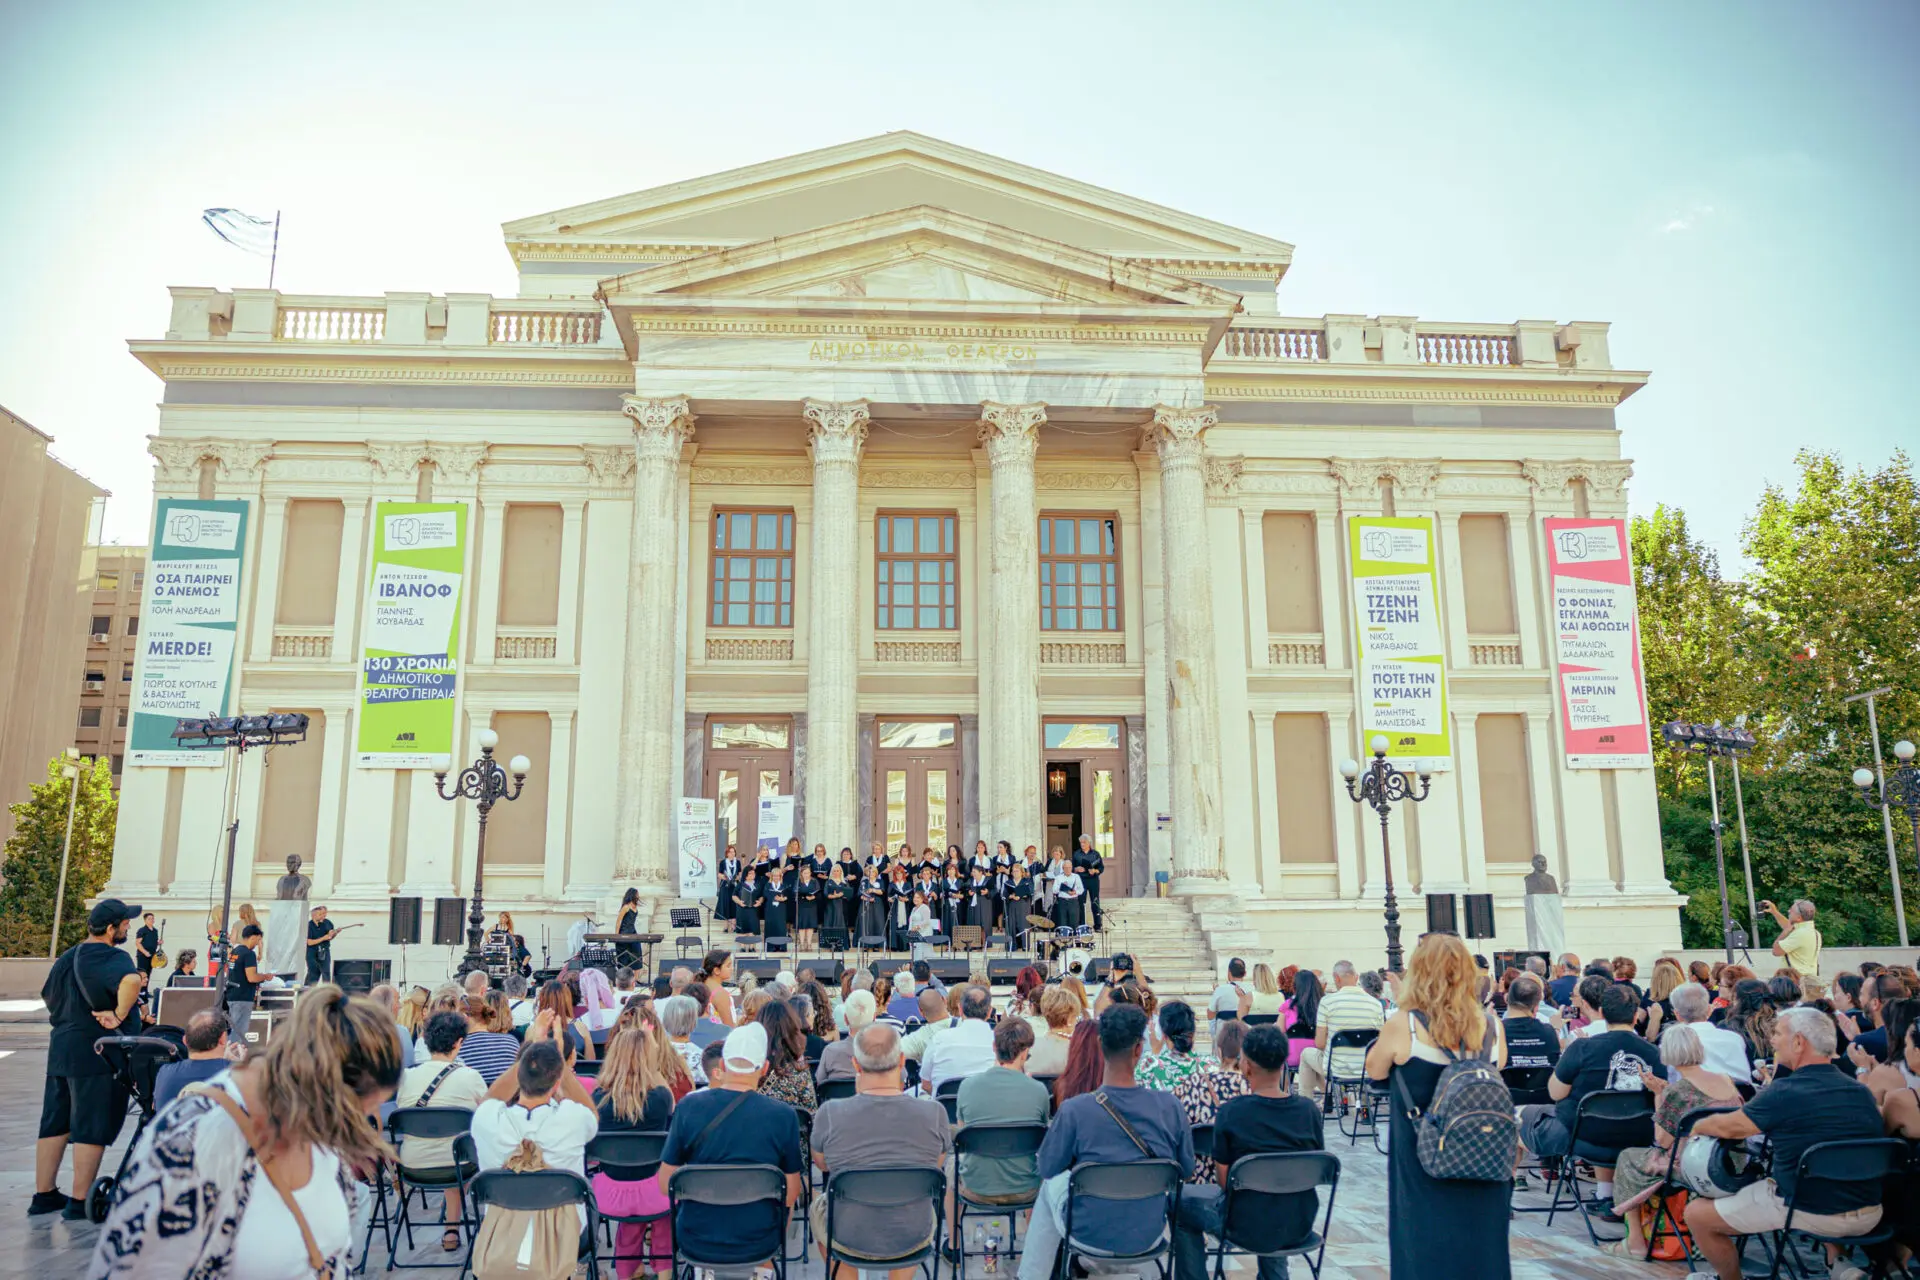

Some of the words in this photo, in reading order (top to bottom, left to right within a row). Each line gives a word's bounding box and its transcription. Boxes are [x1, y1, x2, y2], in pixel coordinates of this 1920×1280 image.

[809, 341, 924, 358] ΔΗΜΟΤΙΚΟΝ
[946, 344, 1037, 359] ΘΕΑΤΡΟΝ
[155, 573, 181, 584] ΟΣΑ
[184, 574, 233, 585] ΠΑΙΡΝΕΙ
[154, 586, 164, 596] Ο
[167, 586, 220, 597] ΑΝΕΜΟΣ
[379, 583, 452, 598] ΙΒΑΝΟΦ
[1366, 594, 1418, 608] ΤΖΕΝΗ
[1558, 598, 1567, 607] Ο
[1569, 598, 1616, 609] ΦΟΝΙΑΣ,
[152, 606, 173, 615] ΙΟΛΗ
[175, 606, 221, 615] ΑΝΔΡΕΑΔΗ
[377, 607, 414, 616] ΓΙΑΝΝΗΣ
[1559, 610, 1609, 619] ΕΓΚΛΗΜΑ
[1367, 609, 1419, 623] ΤΖΕΝΗ
[376, 617, 425, 626] ΧΟΥΒΑΡΔΑΣ
[1560, 622, 1579, 631] ΚΑΙ
[1582, 622, 1630, 631] ΑΘΩΩΣΗ
[1369, 632, 1394, 640] ΝΙΚΟΣ
[147, 641, 212, 656] MERDE!
[1370, 642, 1418, 650] ΚΑΡΑΘΑΝΟΣ
[1563, 650, 1615, 658] ΔΑΔΑΚΑΡΙΔΗΣ
[365, 657, 392, 671] 130
[395, 657, 457, 671] ΧΡΟΝΙΑ
[378, 673, 443, 684] ΔΗΜΟΤΙΚΟ
[1373, 673, 1406, 684] ΠΟΤΕ
[1408, 673, 1435, 684] ΤΗΝ
[143, 680, 177, 689] ΓΙΩΡΓΟΣ
[179, 680, 218, 689] ΚΟΥΤΛΗΣ
[151, 690, 187, 699] ΒΑΣΙΛΗΣ
[363, 688, 409, 699] ΘΕΑΤΡΟ
[412, 688, 455, 699] ΠΕΙΡΑΙΑ
[1373, 687, 1431, 699] ΚΥΡΙΑΚΗ
[1571, 685, 1616, 695] ΜΕΡΙΛΙΝ
[141, 701, 201, 709] ΜΑΓΟΥΛΙΩΤΗΣ
[1572, 705, 1597, 713] ΤΑΣΟΣ
[1374, 708, 1416, 717] ΔΗΜΗΤΡΗΣ
[1375, 718, 1426, 727] ΜΑΛΙΣΣΟΒΑΣ
